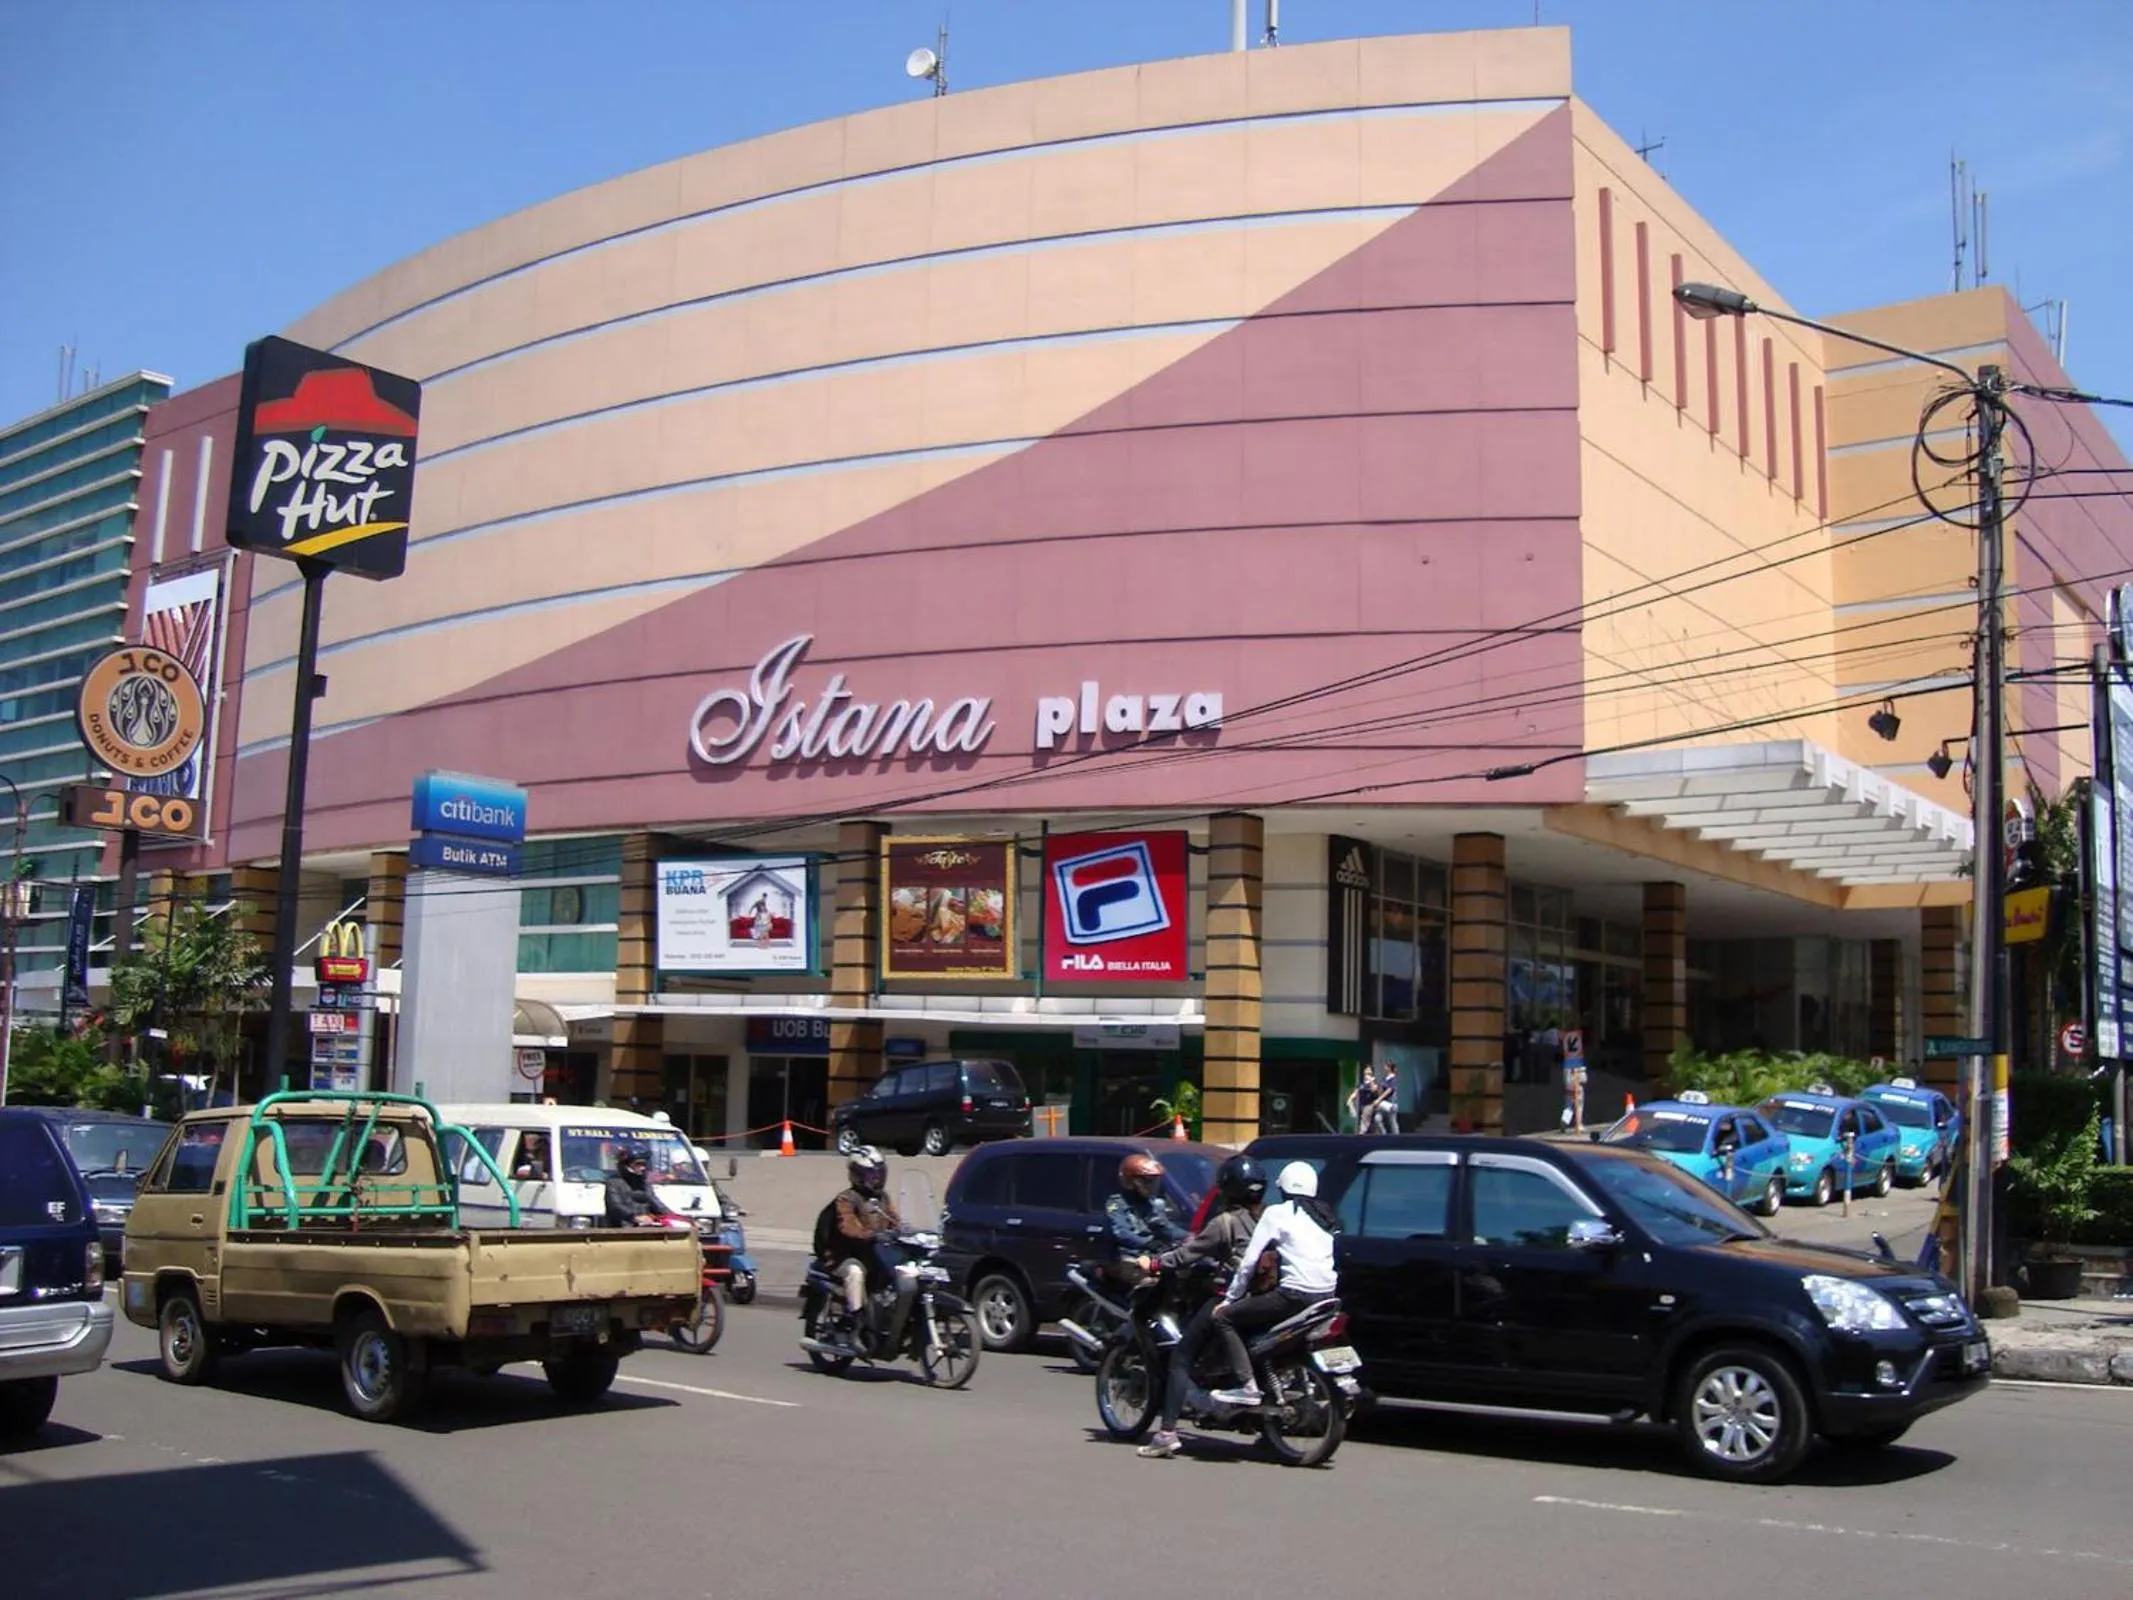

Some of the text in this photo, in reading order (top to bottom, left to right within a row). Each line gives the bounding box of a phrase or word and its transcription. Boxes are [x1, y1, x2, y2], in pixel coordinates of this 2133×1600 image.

[250, 425, 408, 514] Pizza
[276, 480, 395, 540] Hut
[117, 652, 179, 682] J.CO
[689, 633, 1224, 764] Istana plaza
[88, 713, 195, 768] DONUTS & COFFEE
[92, 791, 193, 832] J.CO
[440, 799, 515, 828] citibank
[442, 846, 508, 867] Butik ATM
[664, 869, 704, 886] KPR
[665, 885, 707, 896] BUANA
[1061, 953, 1104, 971] FILA
[1142, 961, 1172, 971] ITALIA
[772, 1019, 808, 1038] UOB
